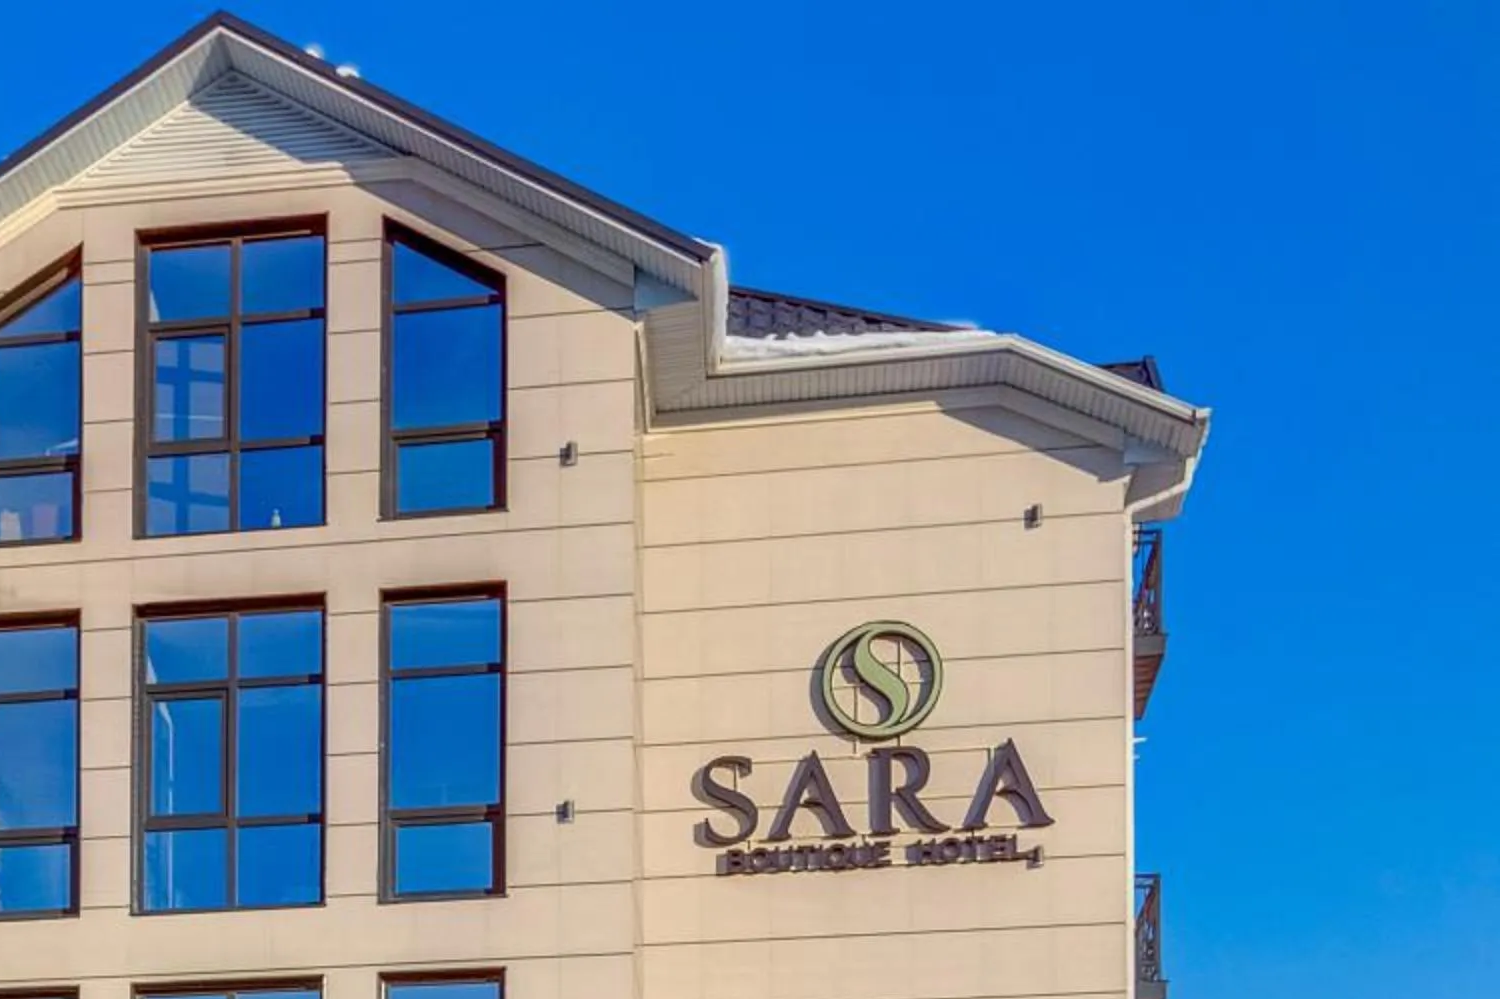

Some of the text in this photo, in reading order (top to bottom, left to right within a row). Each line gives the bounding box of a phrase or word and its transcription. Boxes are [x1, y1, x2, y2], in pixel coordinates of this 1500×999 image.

[694, 738, 1055, 846] SARA
[717, 833, 1033, 875] BOUTIQUE HOTEL
